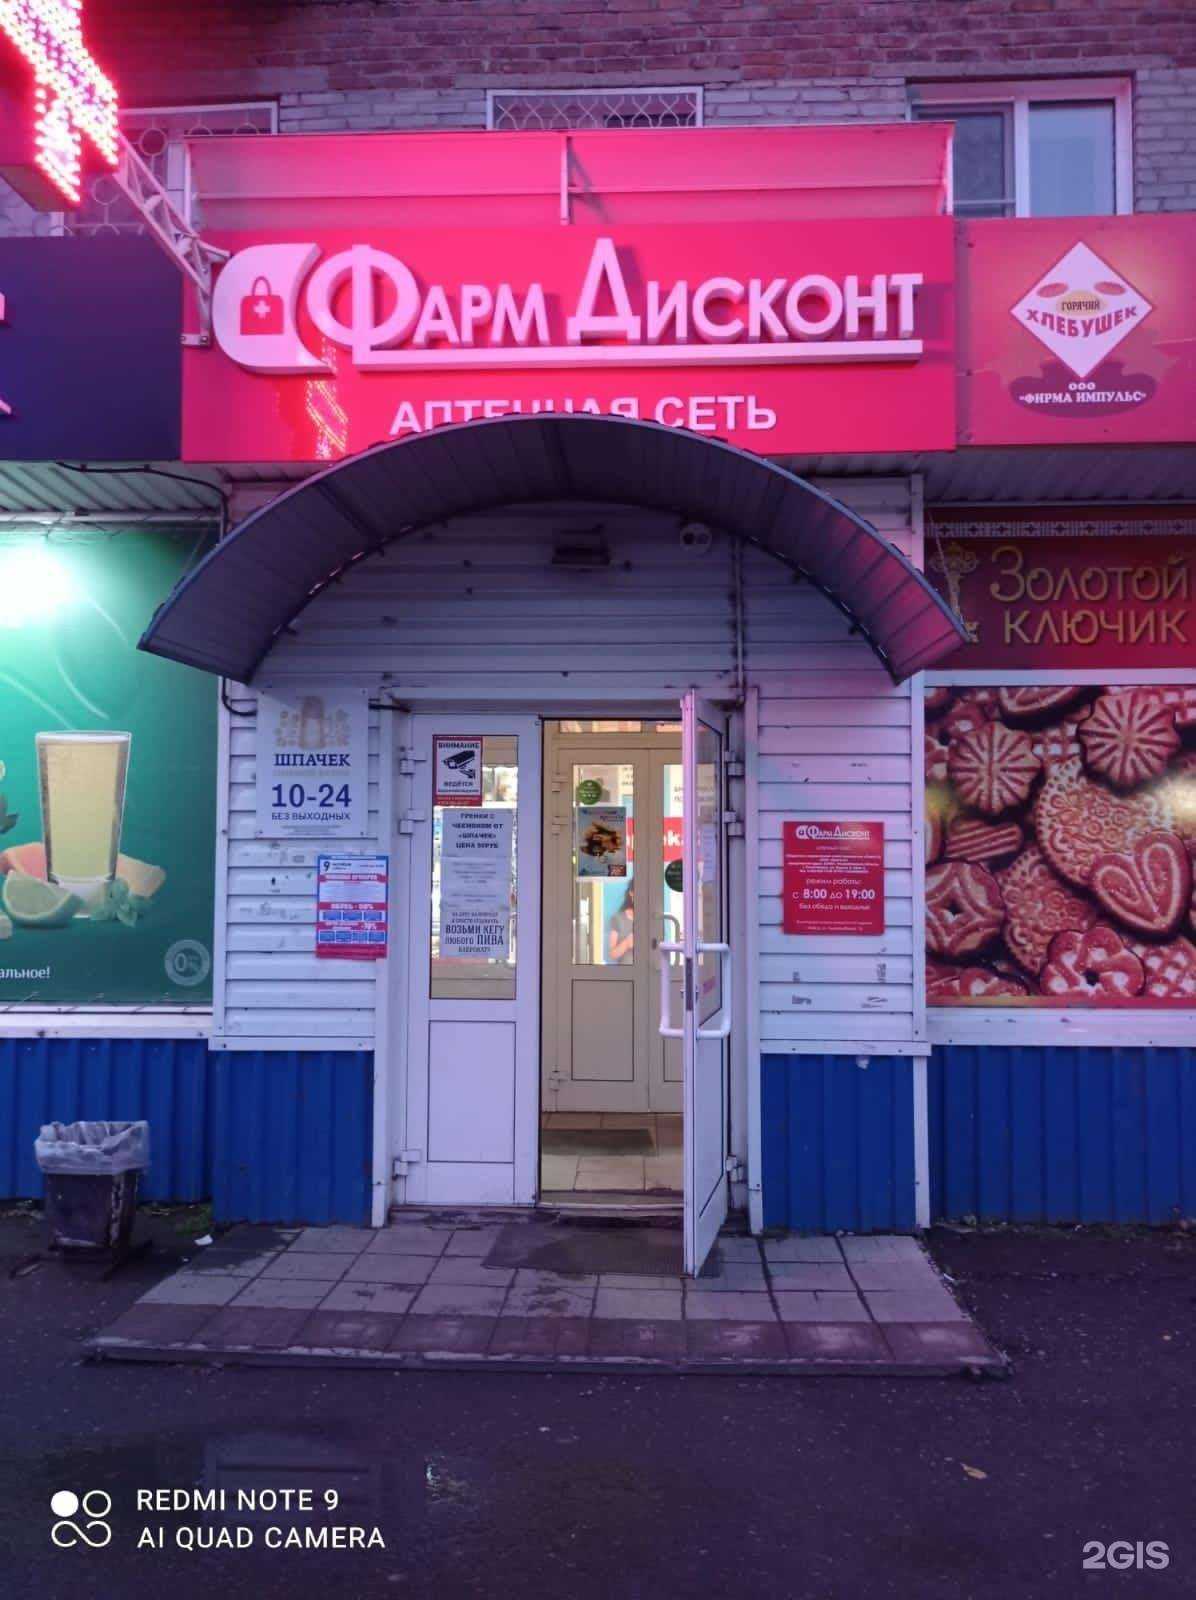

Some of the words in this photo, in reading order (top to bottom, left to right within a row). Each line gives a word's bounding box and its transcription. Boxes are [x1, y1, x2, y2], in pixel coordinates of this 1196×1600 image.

[1026, 306, 1138, 337] ХЛЕБУШЕК
[1068, 382, 1096, 390] ООО
[655, 396, 778, 430] СЕТЬ
[274, 753, 351, 767] ШПАЧЕК
[271, 783, 352, 808] 10-24
[271, 813, 291, 821] БЕЗ
[292, 812, 351, 822] ВЫХОДНЫХ
[803, 888, 827, 899] 8:00
[845, 889, 876, 900] 19:00
